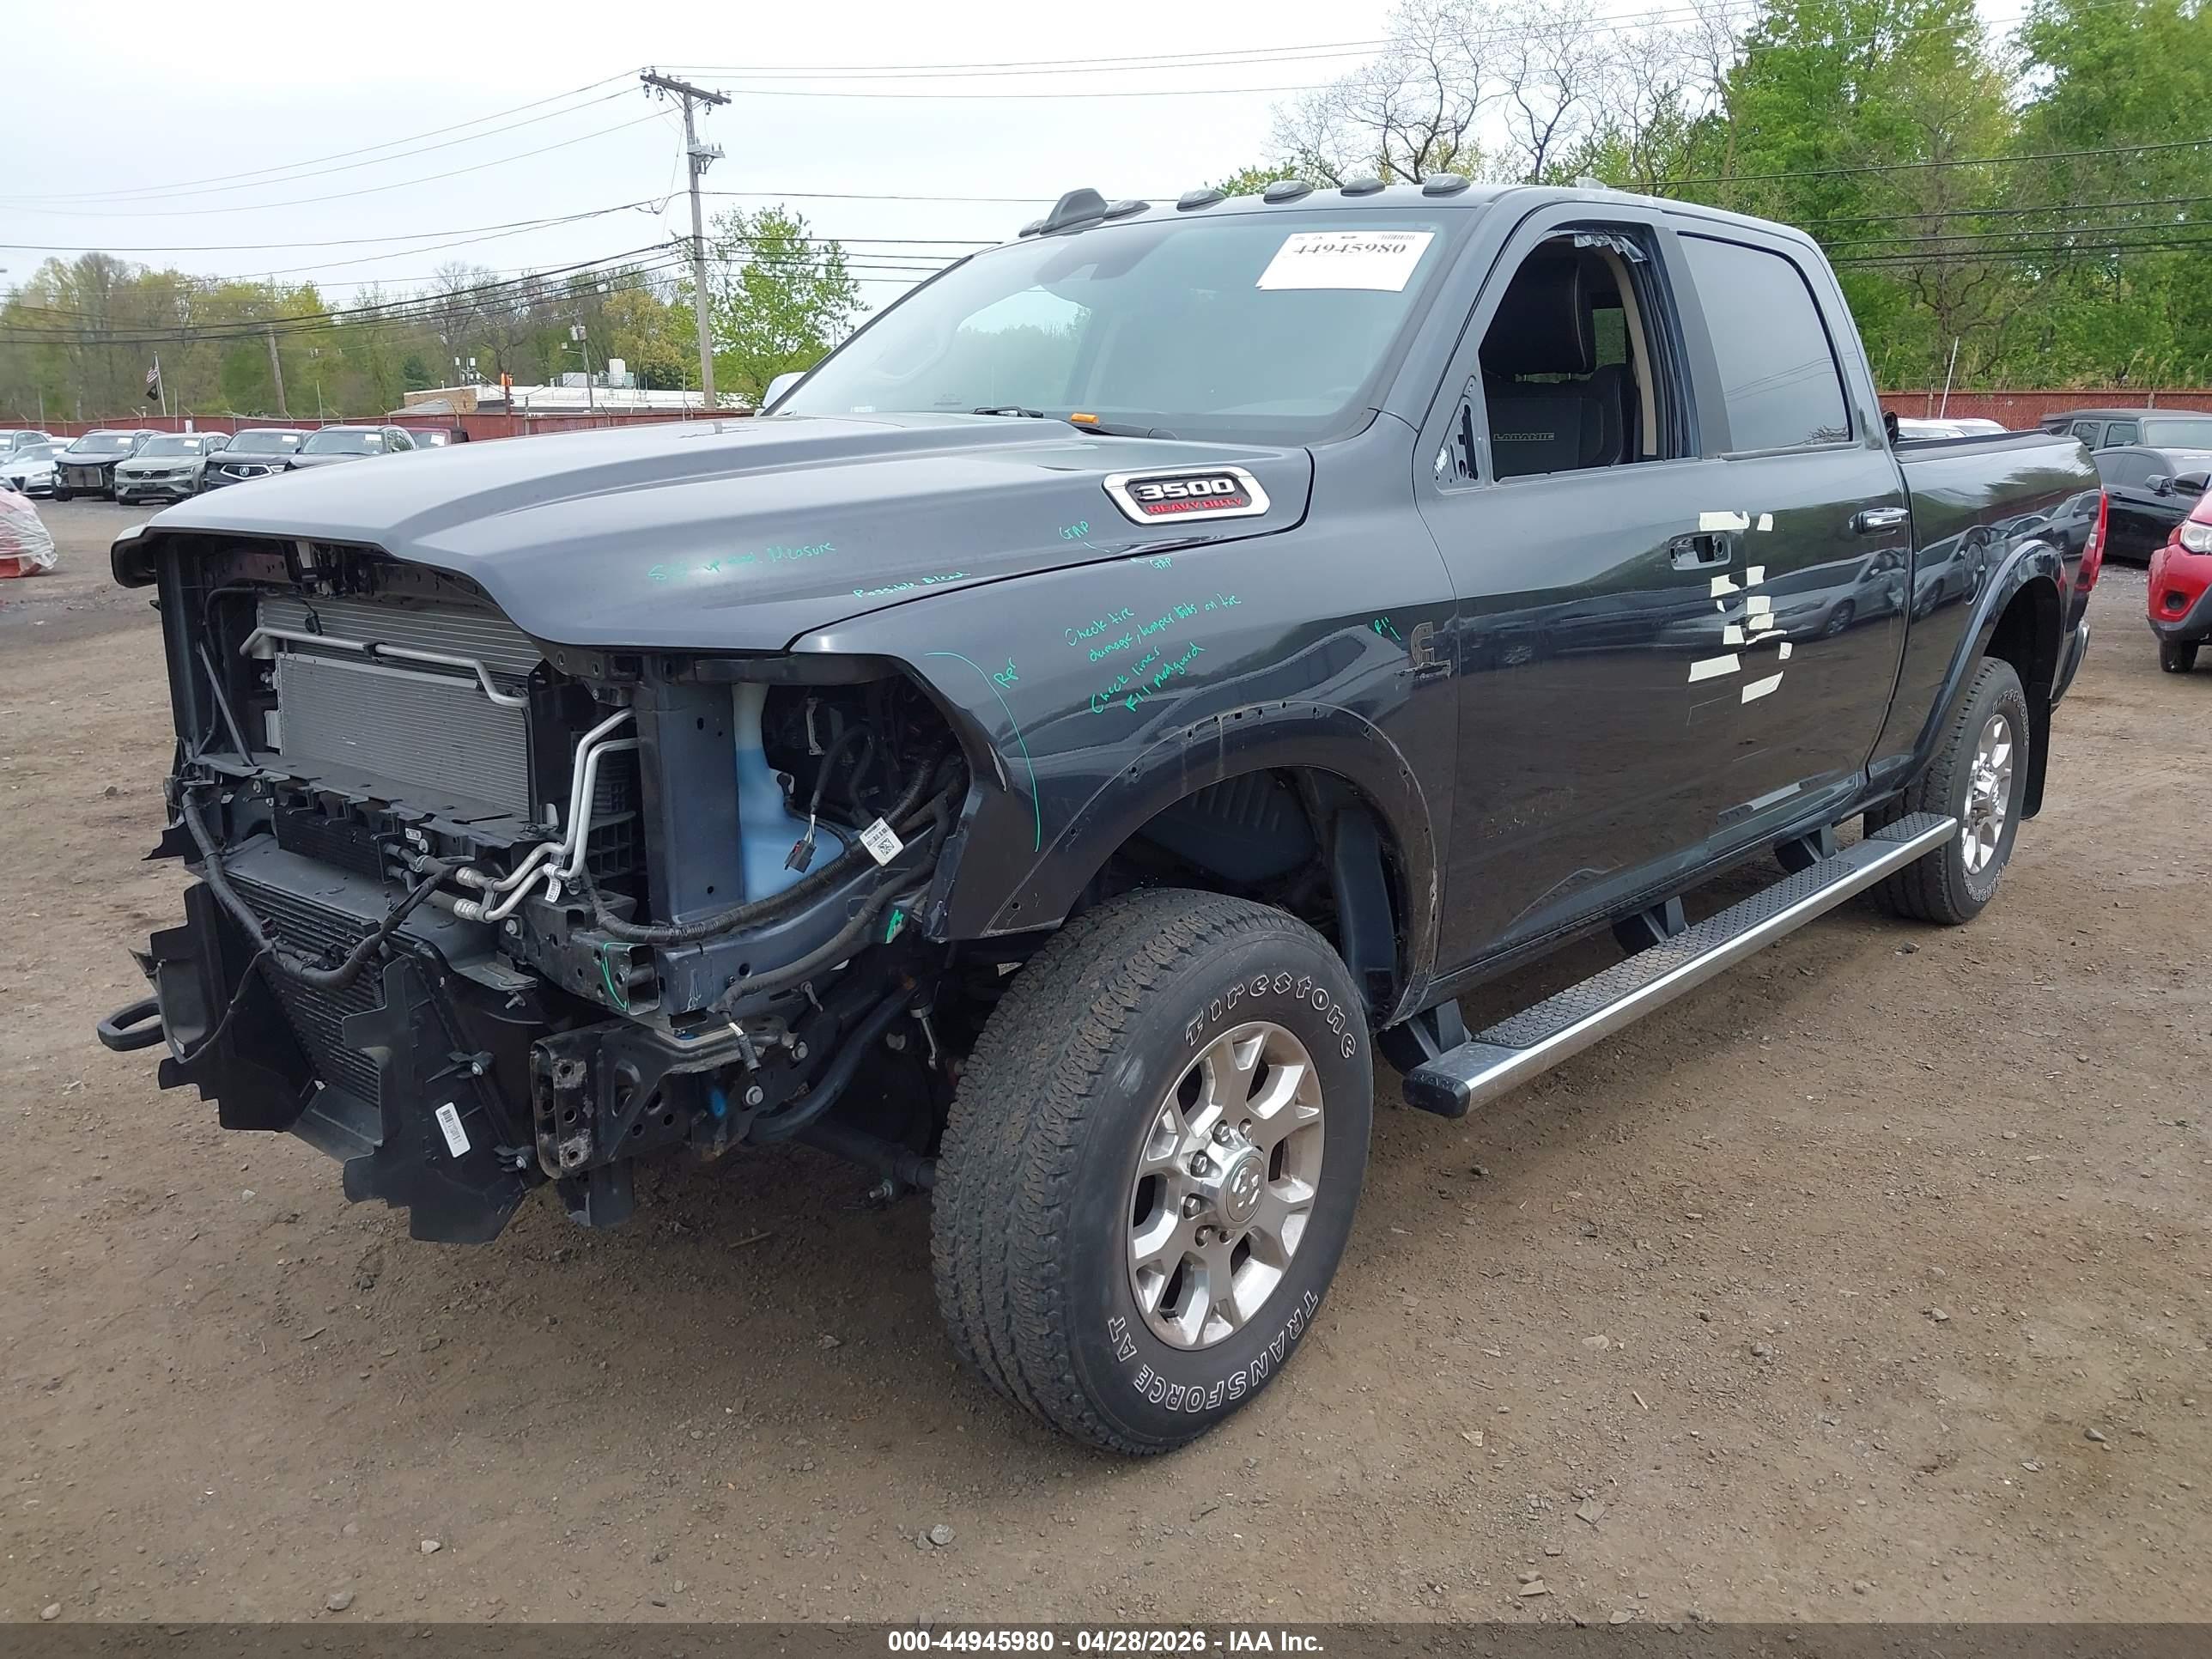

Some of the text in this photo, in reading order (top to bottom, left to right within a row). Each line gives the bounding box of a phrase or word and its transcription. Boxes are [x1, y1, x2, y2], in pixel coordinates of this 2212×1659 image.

[1292, 243, 1407, 255] 44945980
[1136, 478, 1236, 501] 3500
[1147, 497, 1243, 514] HEAVY DUTY
[1059, 520, 1089, 540] GAP
[1149, 557, 1172, 569] GAP
[853, 582, 919, 598] Possible
[1065, 607, 1134, 646] Check tire
[1091, 674, 1129, 714] Check
[1185, 971, 1357, 1059] Firestone
[1107, 1290, 1319, 1414] TRANSFORCE AT
